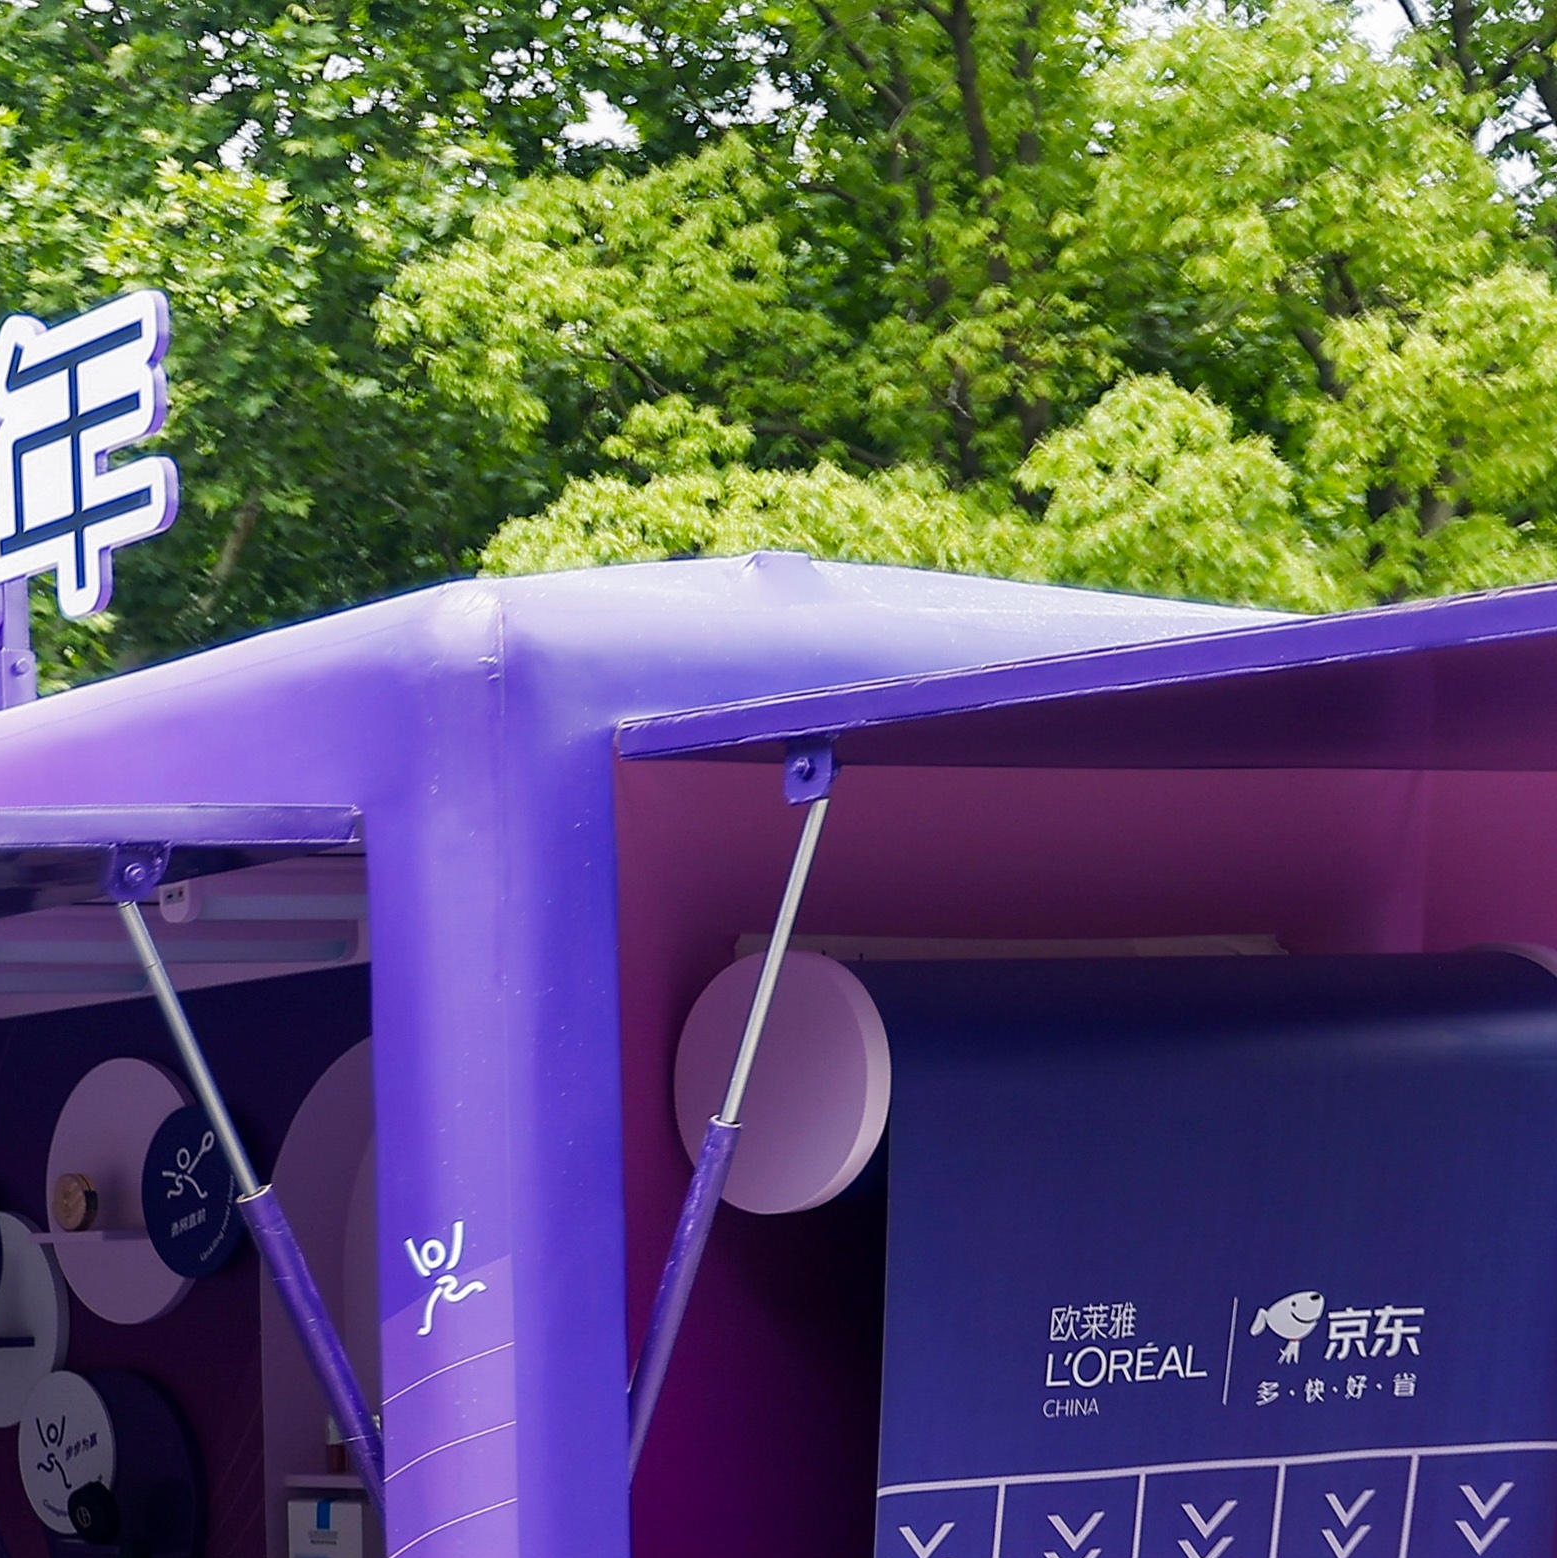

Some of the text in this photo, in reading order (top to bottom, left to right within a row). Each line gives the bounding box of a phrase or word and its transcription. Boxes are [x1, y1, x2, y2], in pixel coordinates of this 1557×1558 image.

[1049, 1301, 1137, 1342] 欧莱雅
[1323, 1305, 1425, 1361] 京东
[1046, 1342, 1208, 1388] L'ORÉAL
[1042, 1397, 1100, 1418] CHINA
